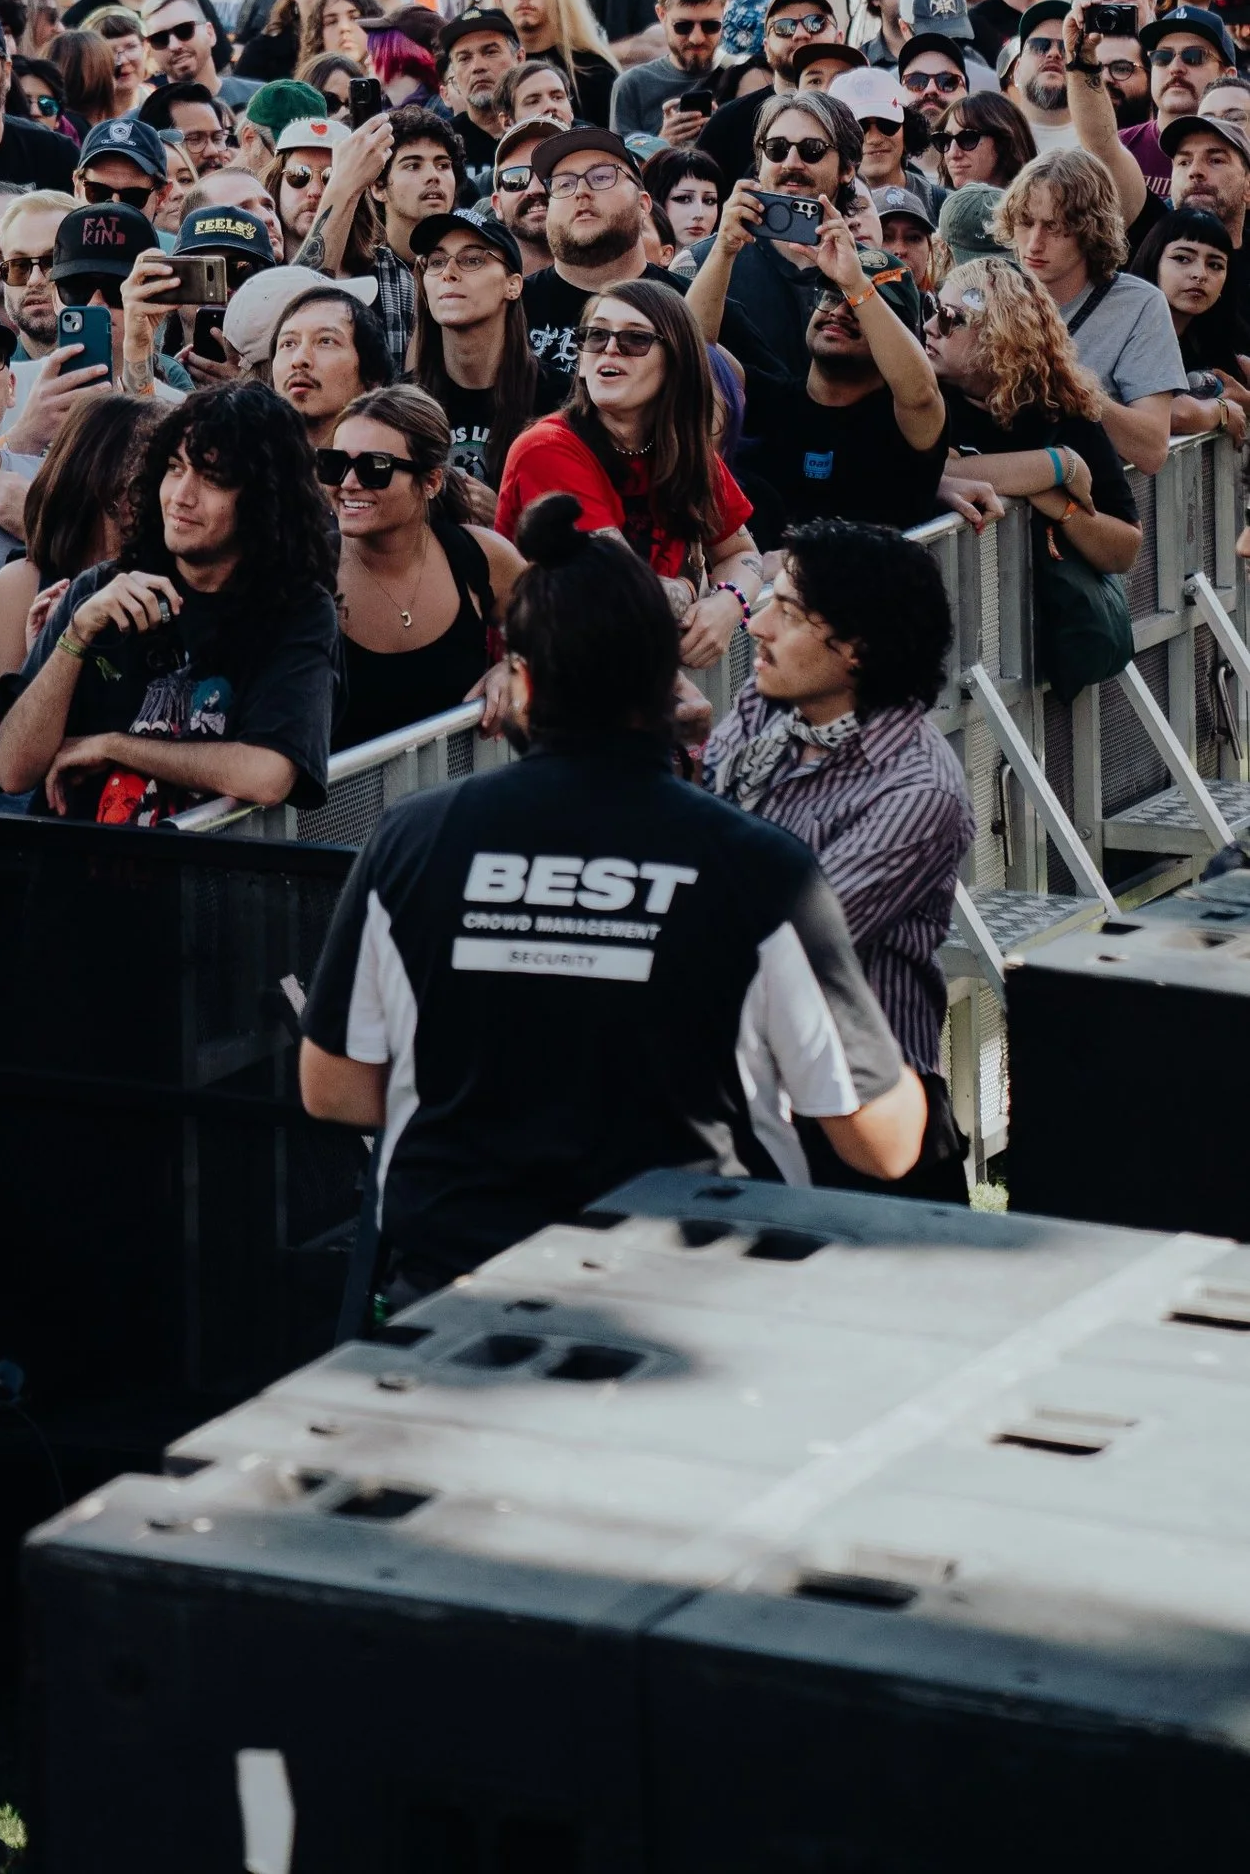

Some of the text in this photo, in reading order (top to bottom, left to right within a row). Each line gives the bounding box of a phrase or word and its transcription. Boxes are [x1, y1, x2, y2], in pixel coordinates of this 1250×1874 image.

[195, 218, 244, 233] FEELS
[463, 851, 699, 915] BEST
[462, 911, 662, 941] CROWD MANAGEMENT
[508, 950, 599, 968] SECURITY
